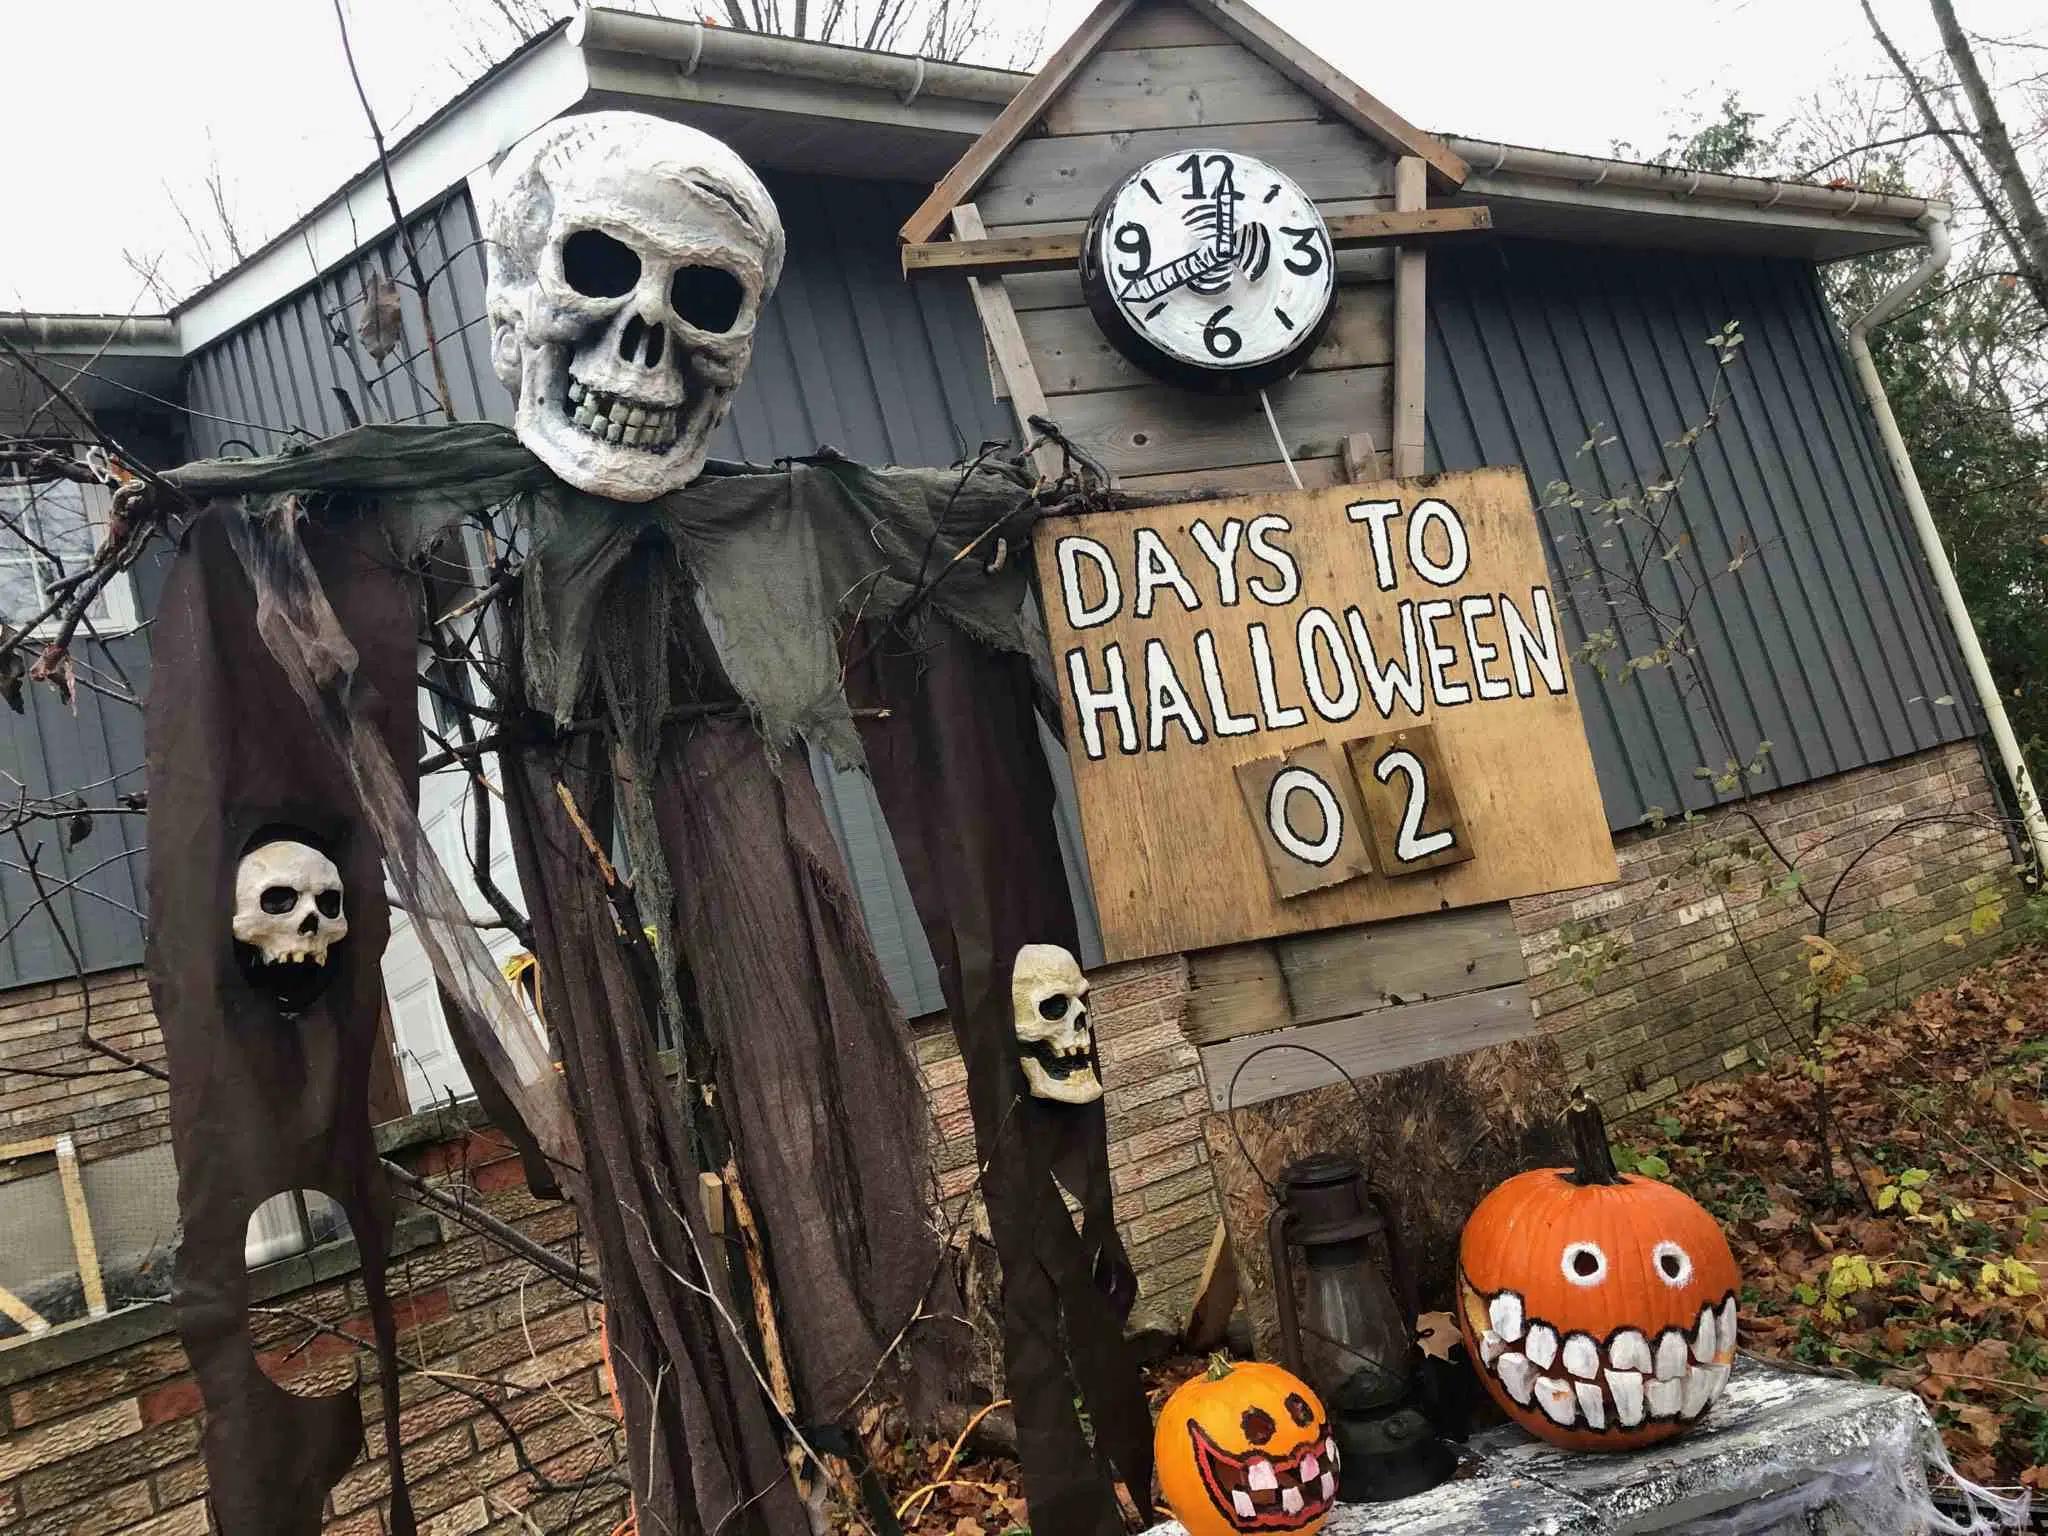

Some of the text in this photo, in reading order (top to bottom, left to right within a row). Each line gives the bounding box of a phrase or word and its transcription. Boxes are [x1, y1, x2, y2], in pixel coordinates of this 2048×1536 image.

[1176, 154, 1245, 200] 12
[1114, 221, 1151, 280] 9
[1279, 226, 1323, 276] 3
[1203, 305, 1242, 358] 6
[1056, 498, 1470, 630] DAYS TO
[1065, 586, 1567, 760] HALLOWEEN
